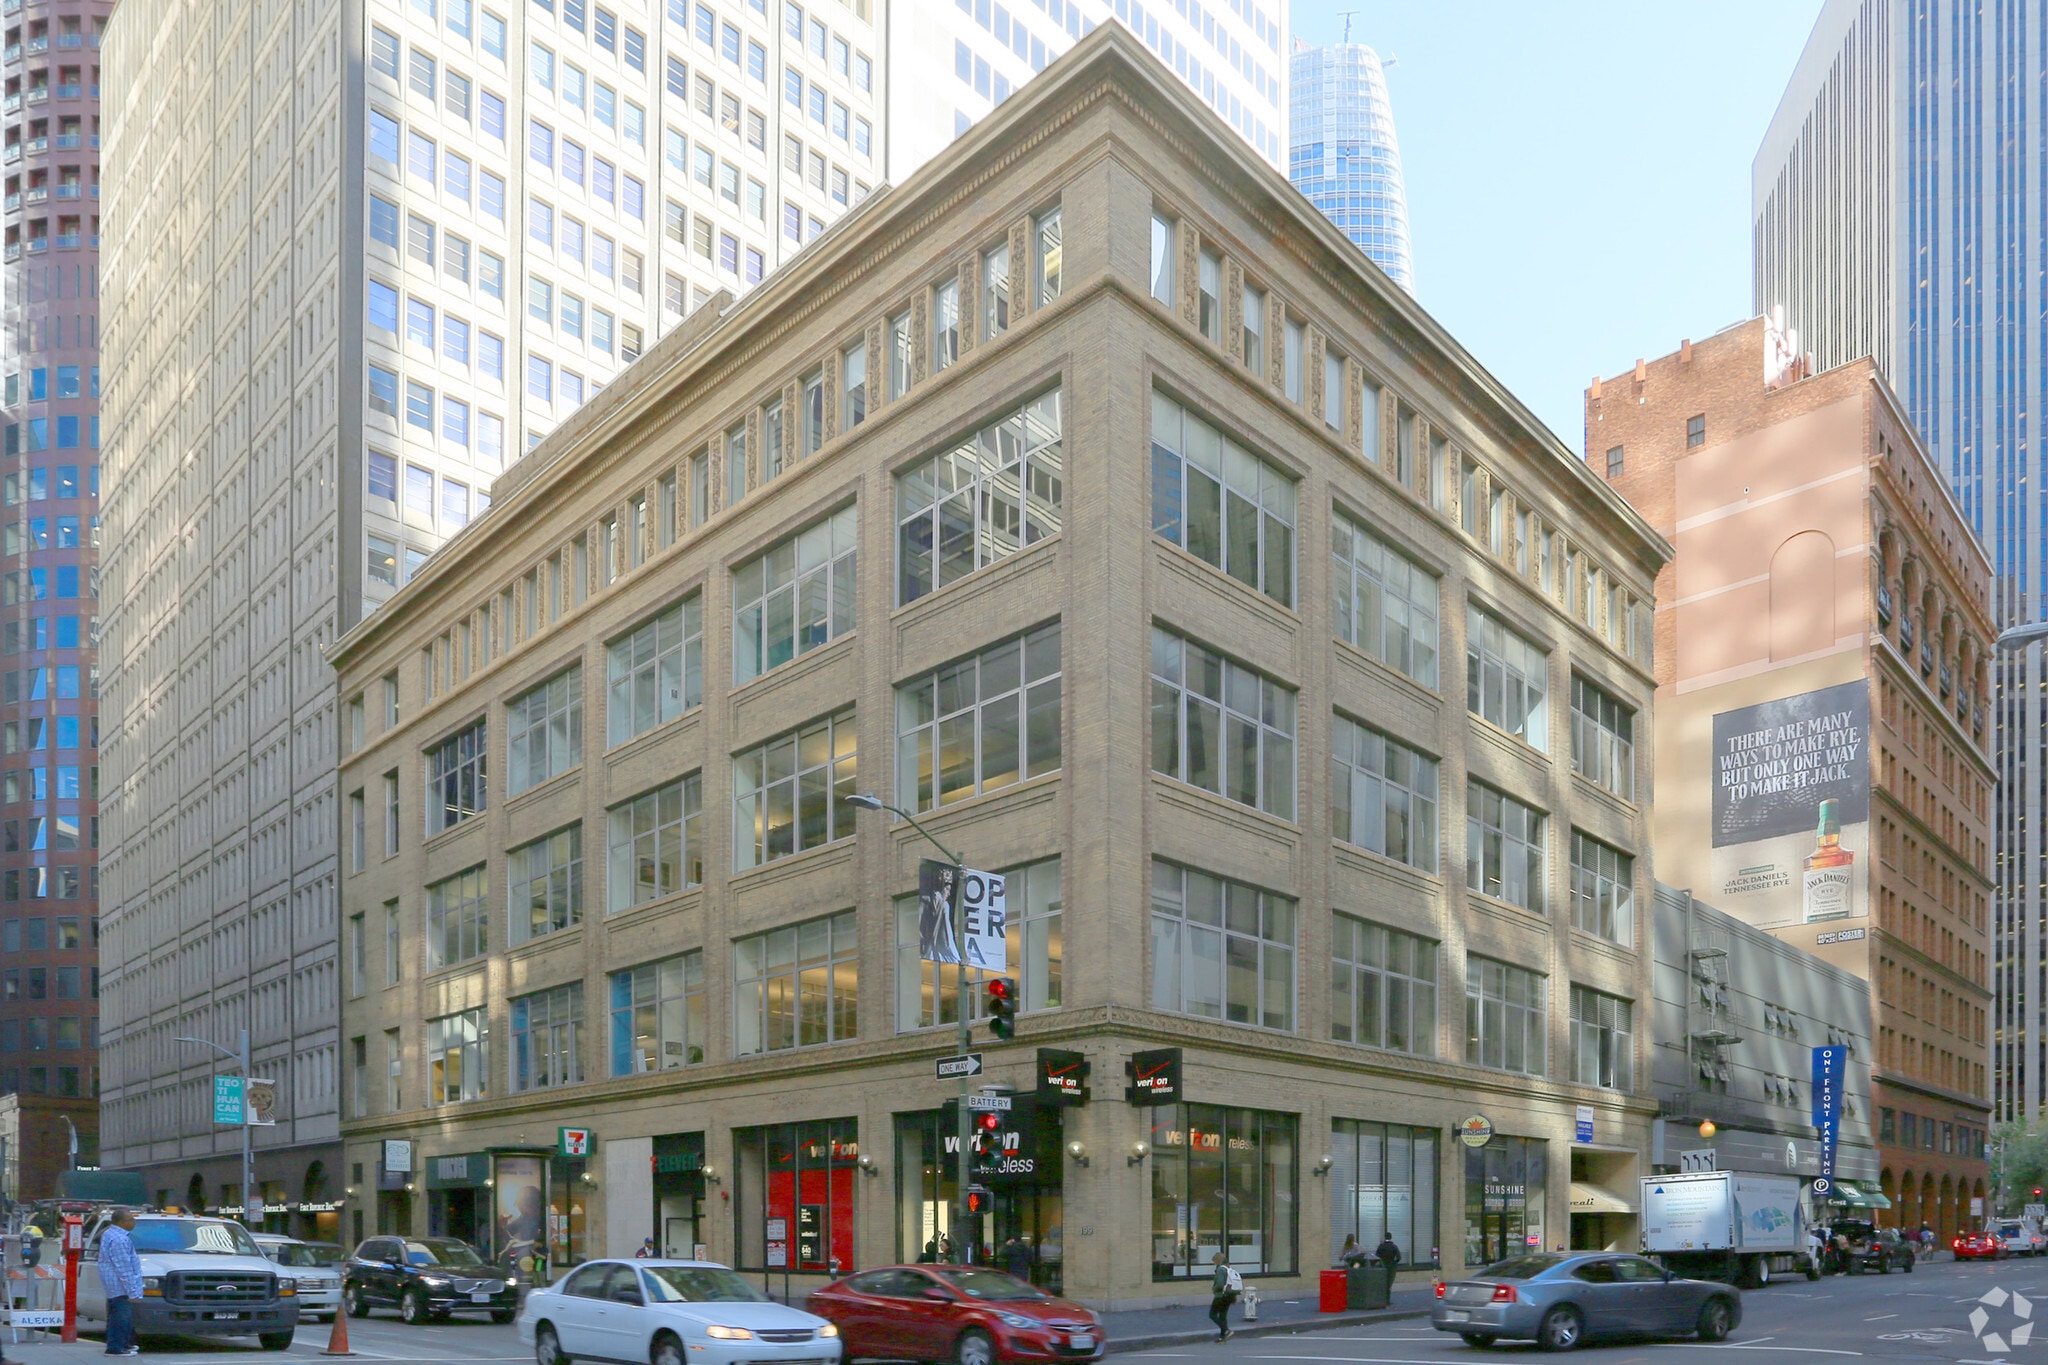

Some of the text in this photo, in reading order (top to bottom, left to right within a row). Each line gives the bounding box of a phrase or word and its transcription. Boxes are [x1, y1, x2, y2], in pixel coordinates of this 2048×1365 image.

[1728, 710, 1853, 753] THERE ARE MANY
[1720, 726, 1861, 771] WAYS TO MAKE RYE,
[1721, 743, 1860, 787] BUT ONLY ONE WAY
[1728, 762, 1851, 802] TO MAKE IT JACK.
[1725, 871, 1788, 888] JACK DANIEL'S
[1807, 877, 1824, 890] JACK
[1723, 878, 1790, 895] TENNESSEE RYE
[940, 1061, 968, 1074] ONE WAY
[1823, 1050, 1832, 1074] ONE
[217, 1078, 239, 1087] TEO
[1048, 1076, 1077, 1088] verizon
[1137, 1077, 1168, 1088] verizon
[217, 1095, 240, 1104] HUA
[970, 1097, 1009, 1108] BATTERY
[217, 1104, 239, 1112] CAN
[1823, 1121, 1831, 1175] PARKING
[1485, 1185, 1524, 1195] SUNSHINE
